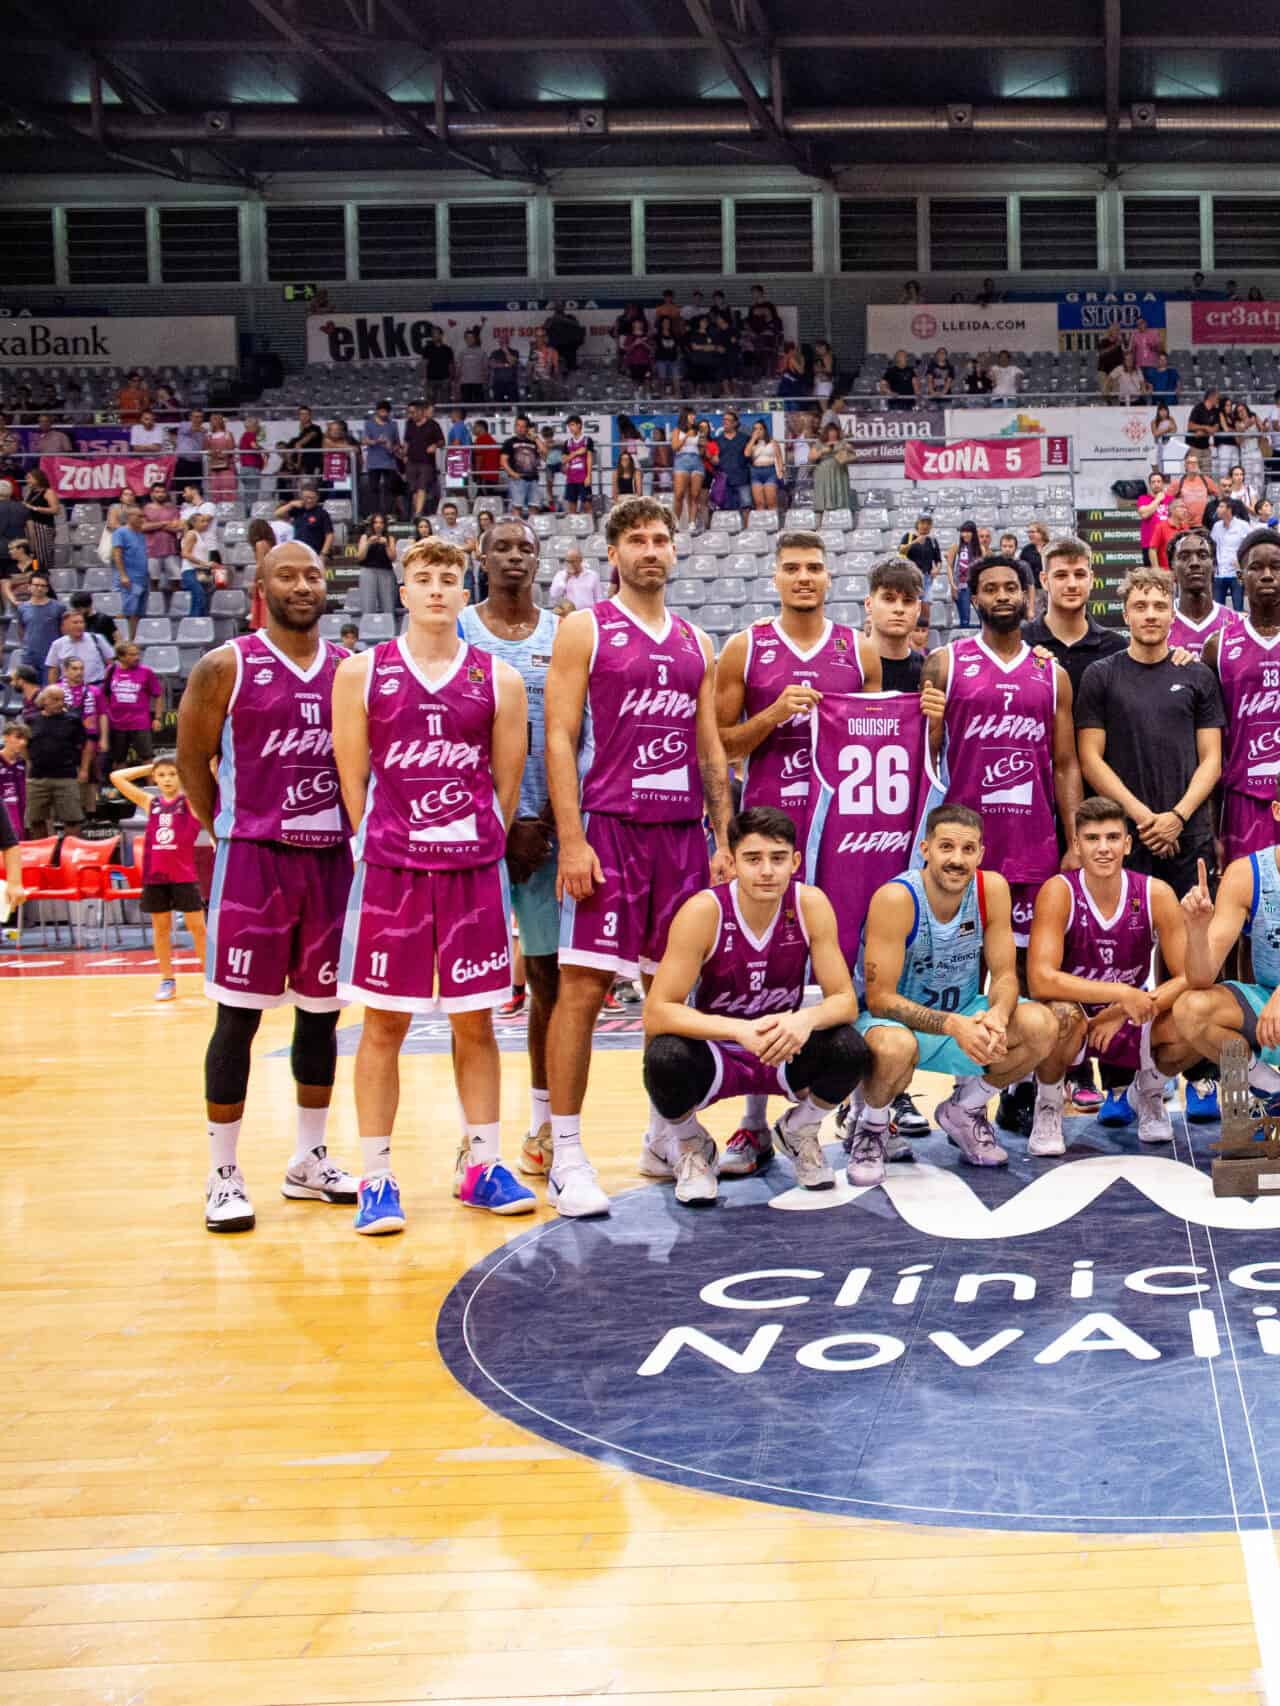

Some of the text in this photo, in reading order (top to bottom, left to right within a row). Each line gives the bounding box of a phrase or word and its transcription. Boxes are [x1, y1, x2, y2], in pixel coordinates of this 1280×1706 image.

[1065, 292, 1157, 302] GRADA
[941, 319, 1026, 331] LLEIDA.COM
[0, 325, 111, 356] xaBank
[922, 446, 991, 473] ZONA
[1005, 448, 1022, 472] 5
[58, 463, 127, 491] ZONA
[658, 664, 668, 685] 3
[1262, 669, 1280, 688] 33
[300, 702, 320, 725] 41
[1003, 692, 1014, 711] 7
[426, 713, 442, 736] 11
[963, 714, 1046, 742] LLEIDA
[261, 728, 334, 758] LLEI
[383, 739, 482, 770] LLEIDA
[637, 731, 682, 766] ICG
[784, 748, 810, 775] IC
[984, 751, 1025, 784] ICG
[286, 770, 334, 806] ICG
[838, 744, 911, 816] 26
[410, 781, 463, 820] ICG
[632, 791, 691, 803] Software
[781, 799, 807, 808] Soft
[981, 806, 1033, 816] Software
[281, 832, 344, 843] Software
[408, 843, 480, 854] Software
[837, 830, 913, 853] LLEIDA
[603, 911, 617, 937] 3
[227, 946, 253, 976] 41
[370, 951, 389, 978] 11
[921, 985, 960, 1012] 20
